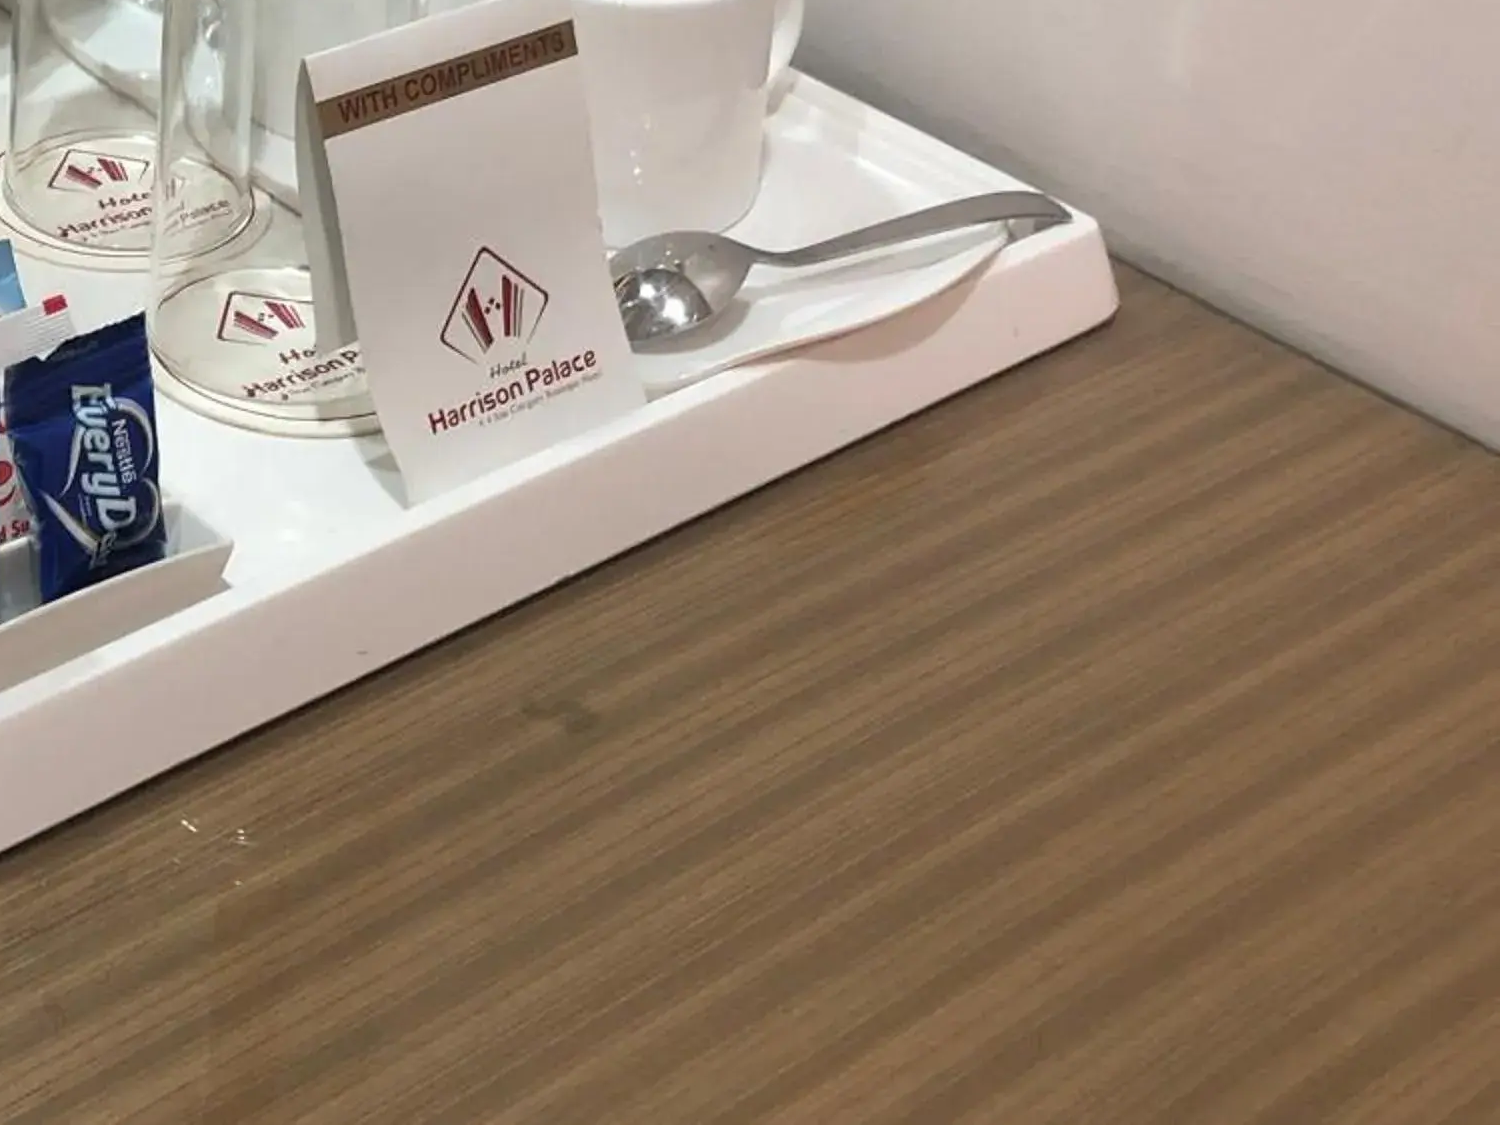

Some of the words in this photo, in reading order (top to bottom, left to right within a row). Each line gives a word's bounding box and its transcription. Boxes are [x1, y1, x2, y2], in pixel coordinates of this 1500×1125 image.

[338, 85, 399, 124] WITH
[404, 30, 566, 102] COMPLIMENTS
[427, 380, 525, 436] Harrison
[524, 349, 598, 393] Palace
